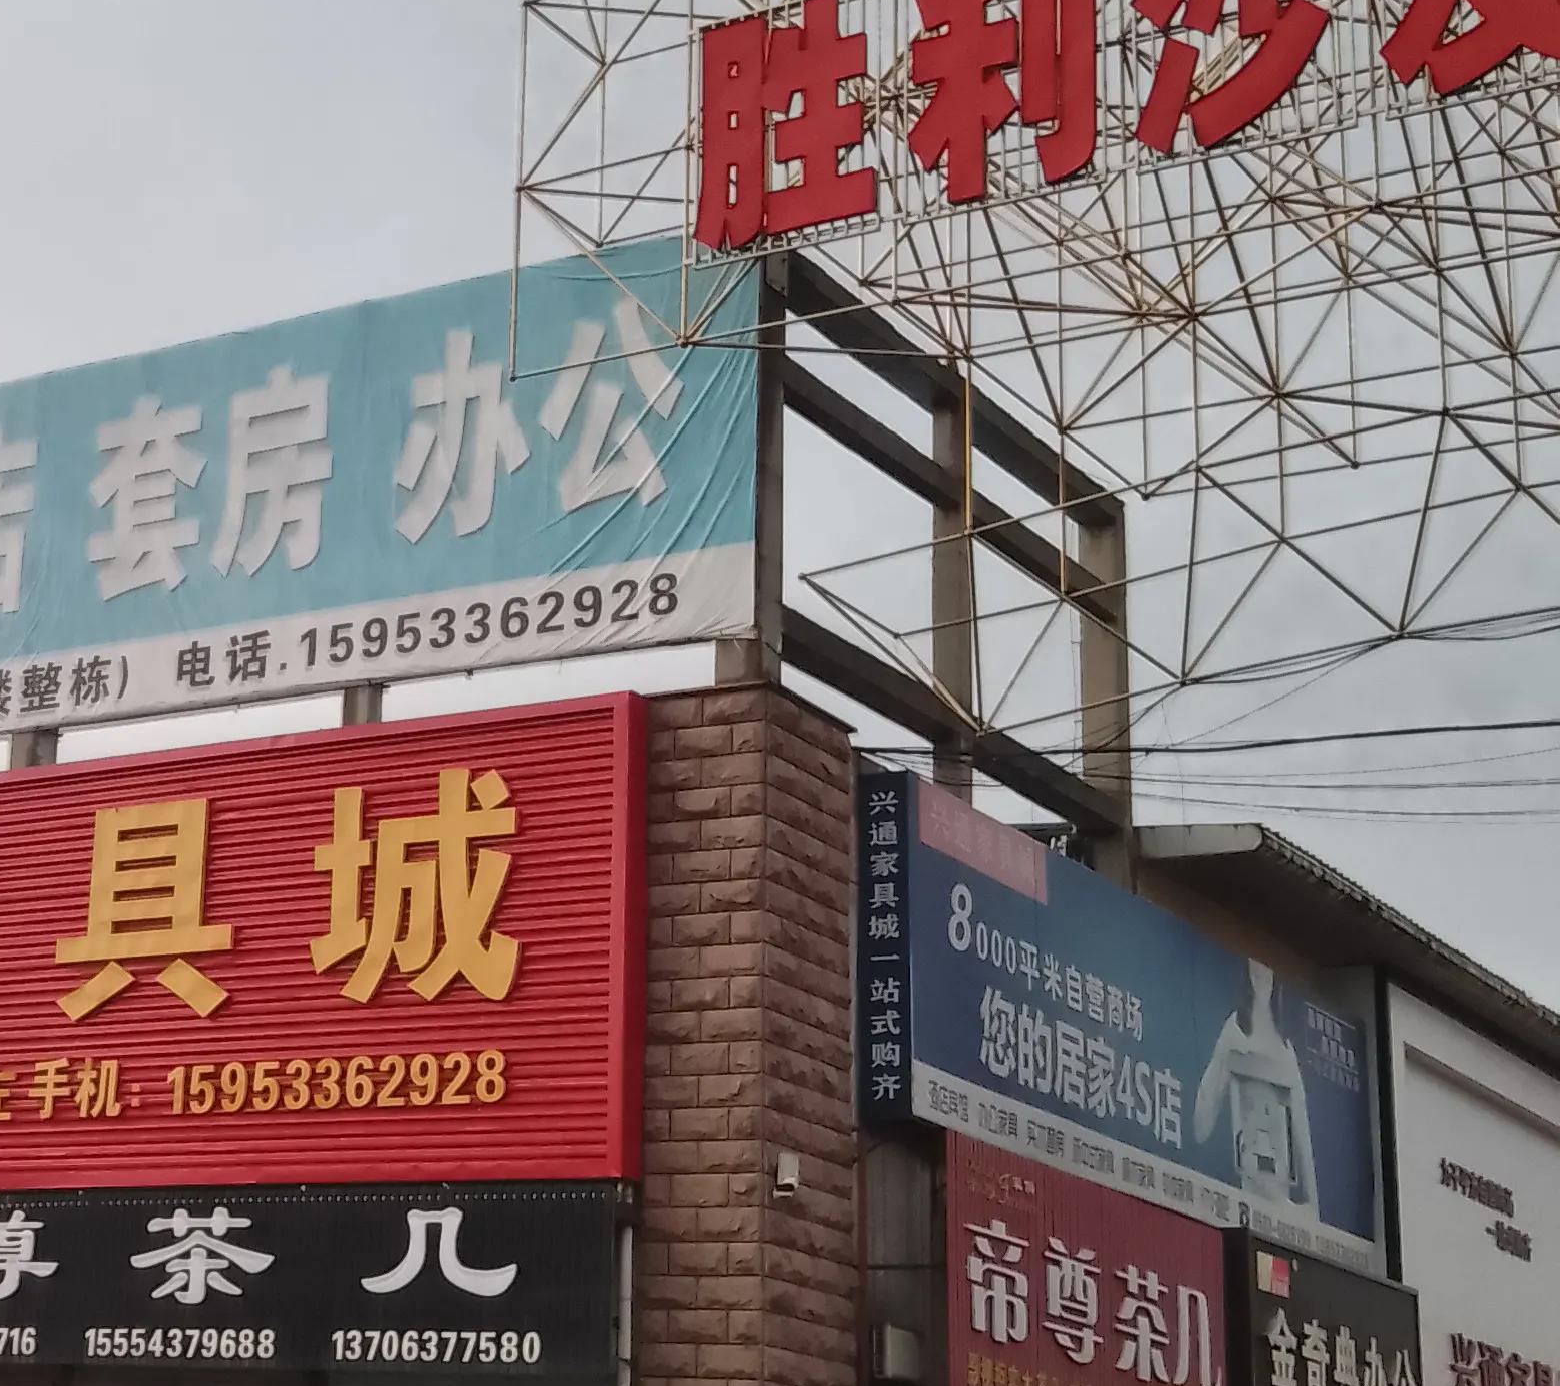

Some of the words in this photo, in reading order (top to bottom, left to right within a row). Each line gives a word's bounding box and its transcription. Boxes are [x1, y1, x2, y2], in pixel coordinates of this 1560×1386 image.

[88, 364, 332, 603] 套房
[396, 299, 685, 545] 办公
[868, 791, 900, 1103] 兴通家具城一站式购齐
[166, 1048, 507, 1115] 15953362928
[979, 986, 1183, 1150] 您的居家4S店
[84, 1326, 277, 1361] 15554379688
[331, 1327, 544, 1365] 13706377580
